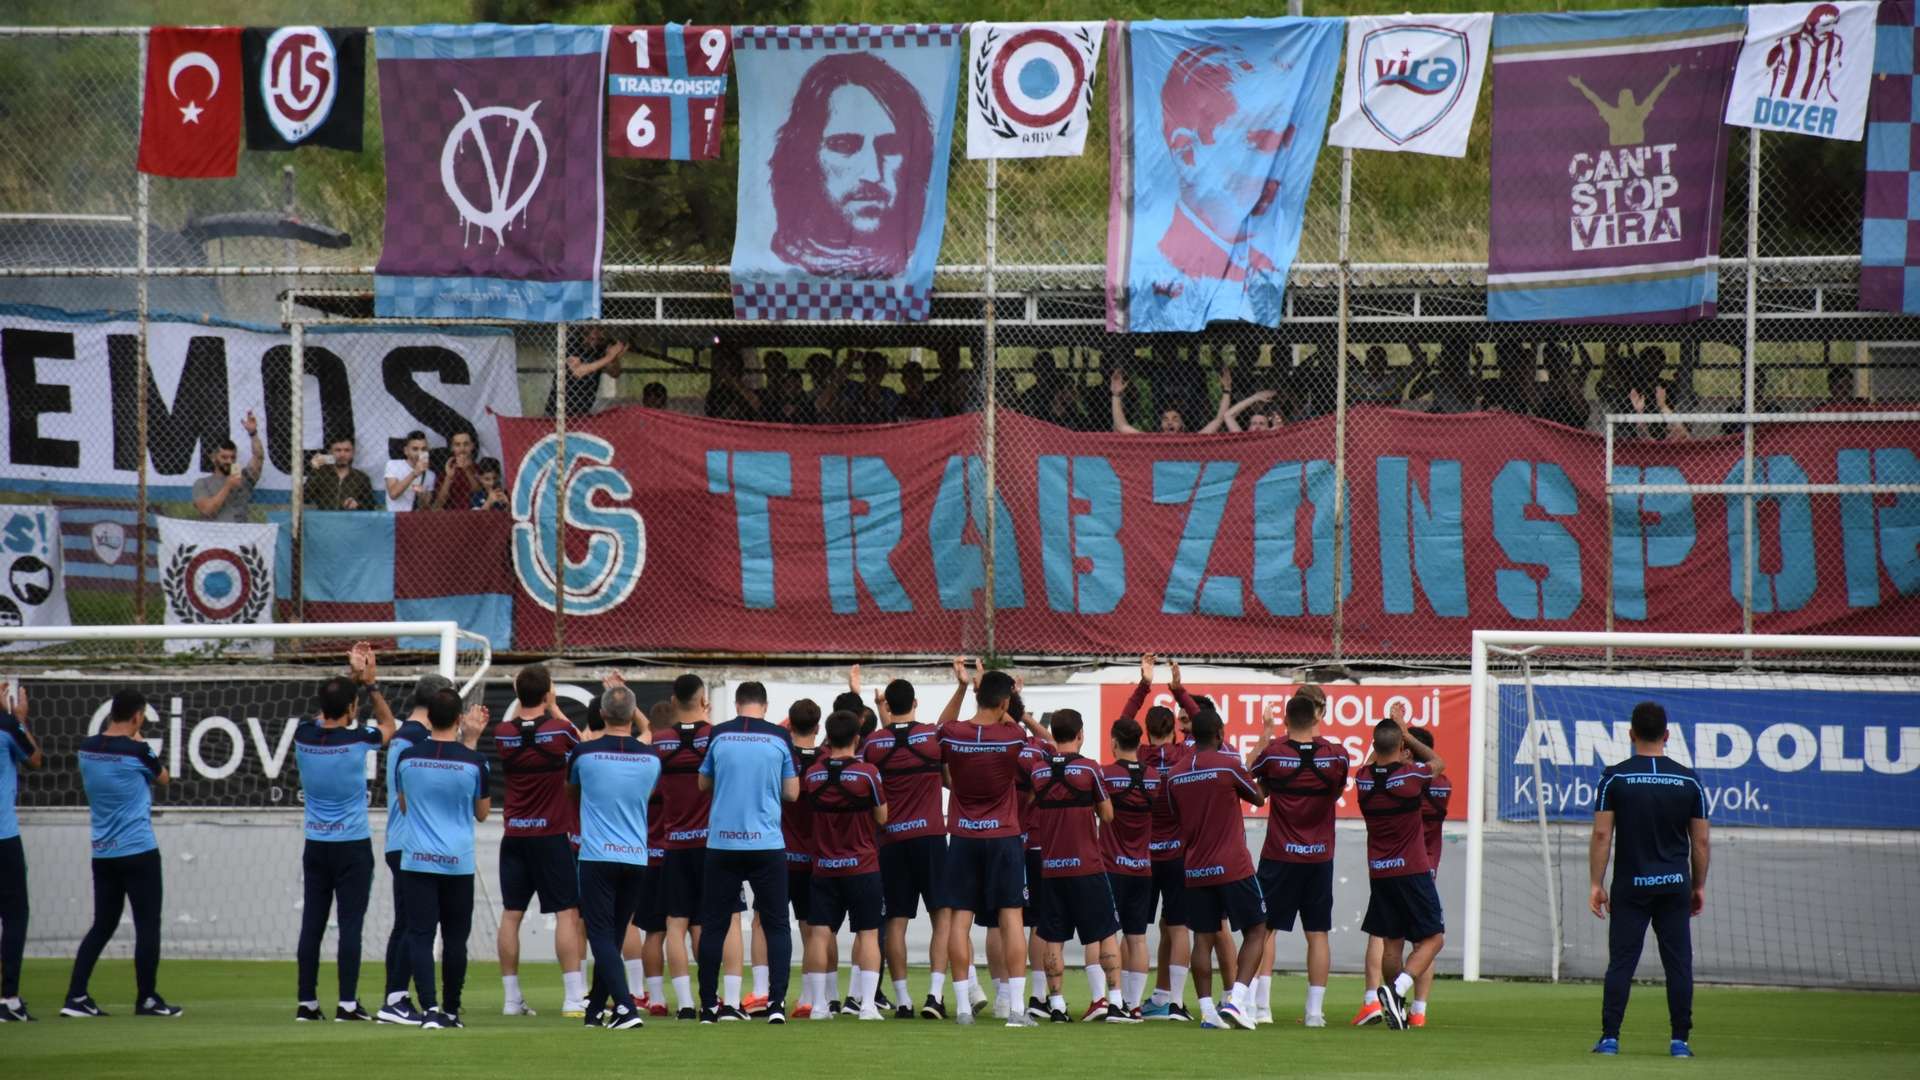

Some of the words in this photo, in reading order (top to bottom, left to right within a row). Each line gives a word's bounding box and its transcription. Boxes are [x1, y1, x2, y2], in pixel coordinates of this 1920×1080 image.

[628, 29, 650, 69] 1
[700, 29, 726, 71] 9
[618, 77, 727, 96] TRABZONSPO
[626, 103, 656, 148] 6
[1753, 97, 1838, 135] DOZER
[1568, 143, 1678, 182] CAN'T
[1570, 174, 1679, 217] STOP
[1, 327, 482, 477] EMOS
[706, 446, 1920, 621] TRABZONSPOR
[1238, 688, 1440, 728] TENOLOJİ
[1626, 777, 1685, 787] TRABZONSPOR
[958, 818, 999, 830] macron
[719, 831, 762, 841] macron
[412, 851, 460, 865] macron
[1285, 843, 1326, 855] macron
[818, 858, 859, 869] macron
[1185, 866, 1225, 878] macron
[1634, 873, 1684, 887] macron
